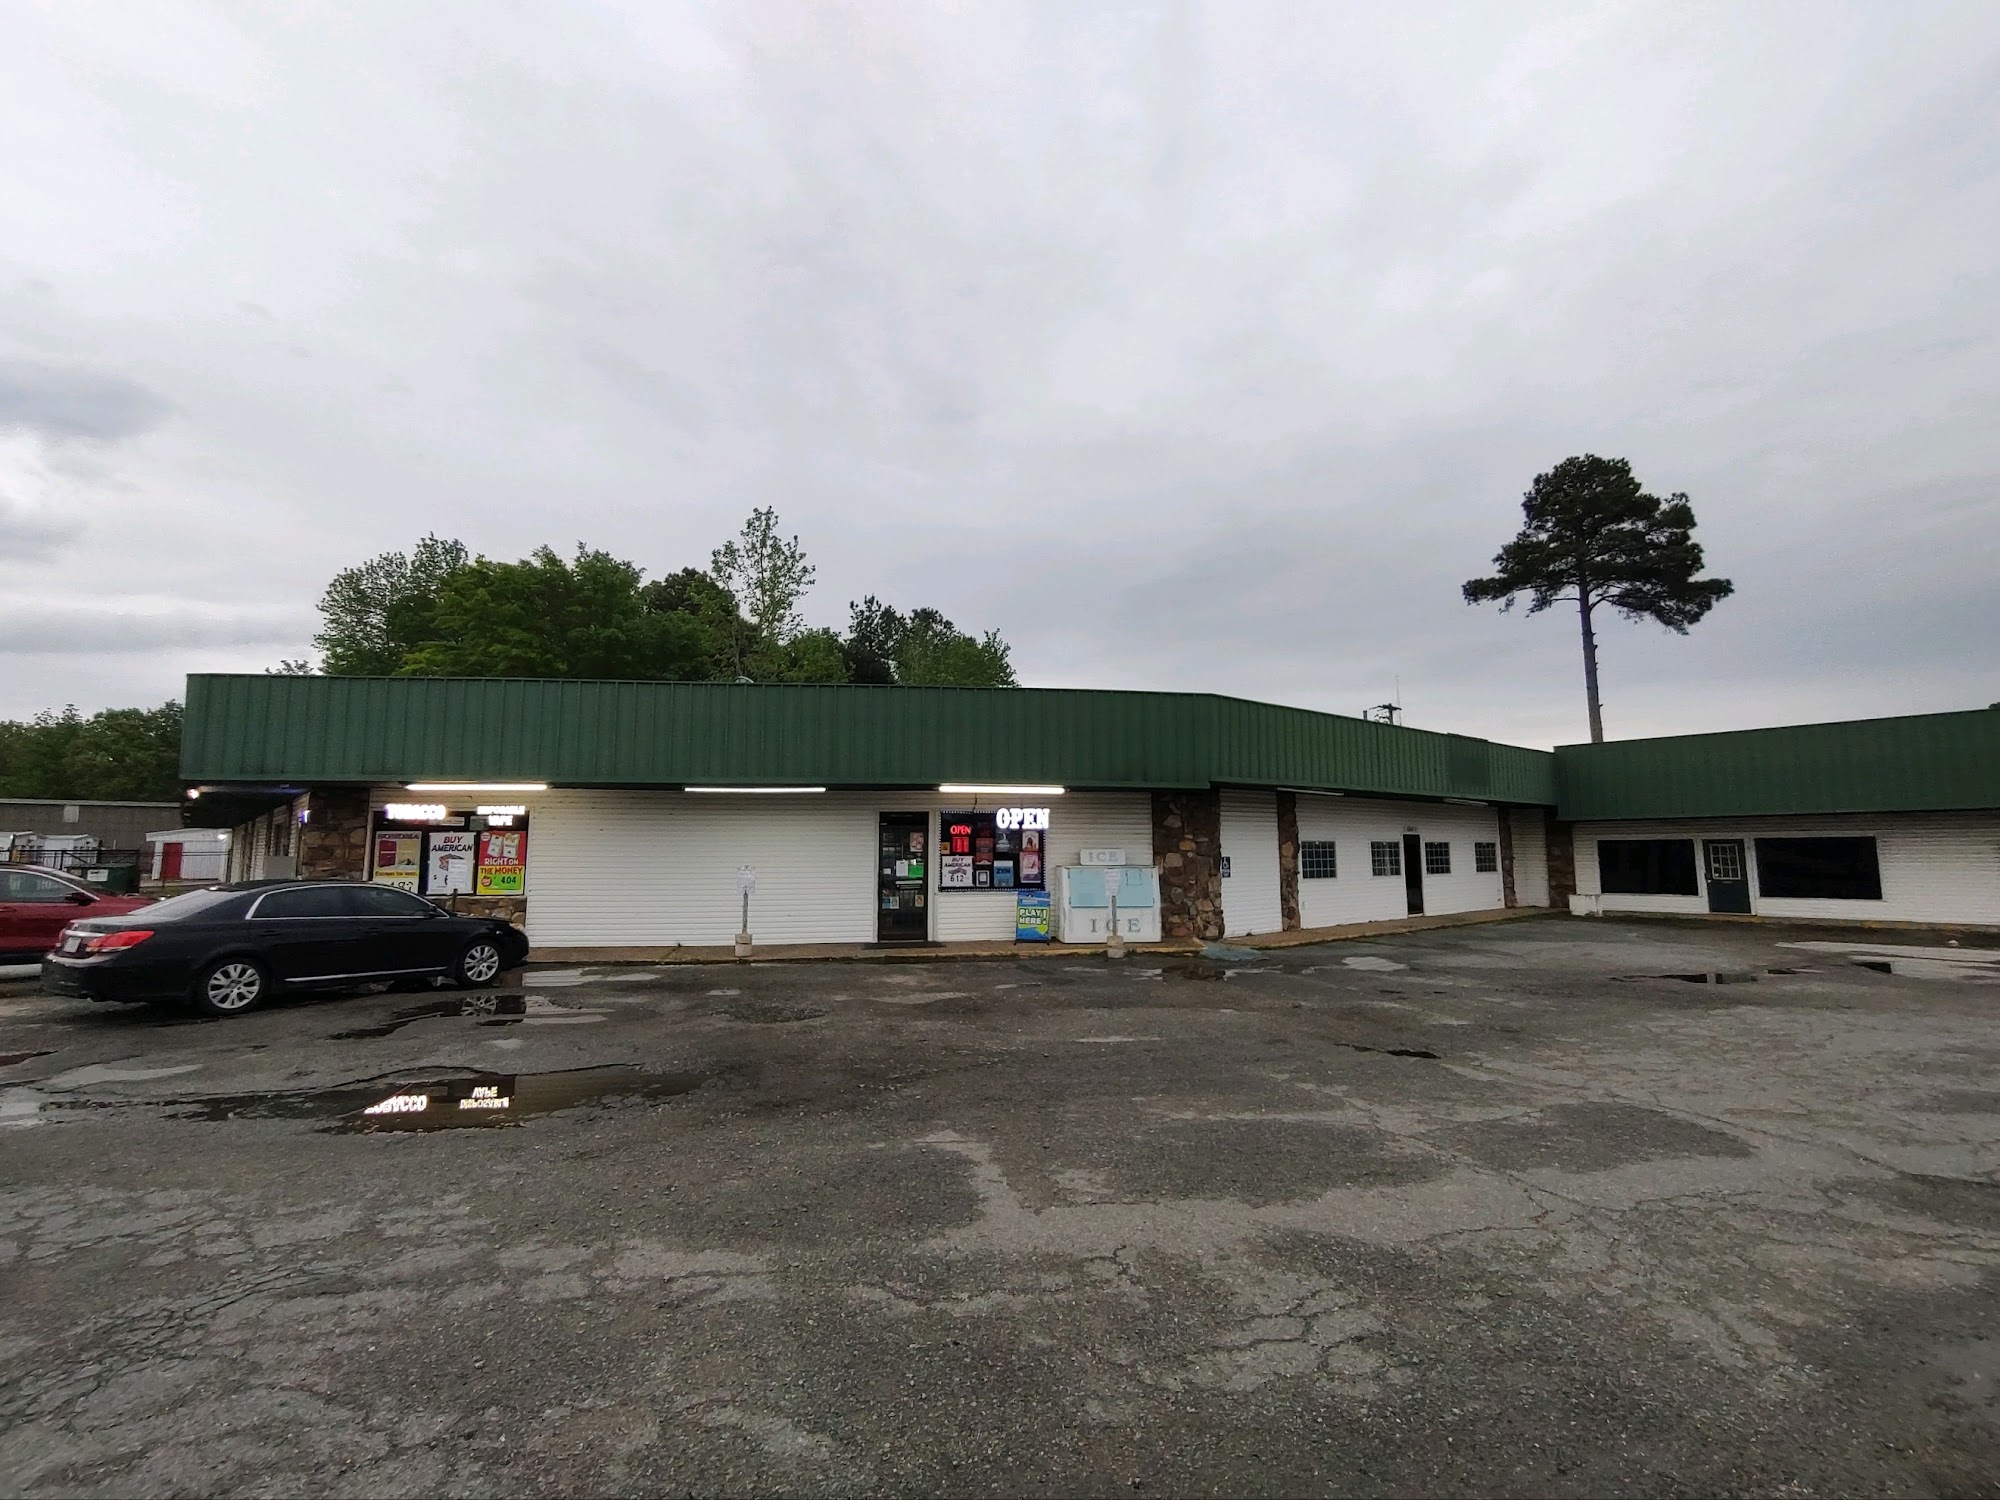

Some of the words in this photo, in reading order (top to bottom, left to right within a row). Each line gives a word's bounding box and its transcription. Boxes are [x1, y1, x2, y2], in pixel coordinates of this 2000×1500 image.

[996, 808, 1050, 829] OPEN
[950, 824, 972, 835] OPEN
[443, 835, 465, 844] BUY
[431, 844, 473, 852] AMERICAN
[1088, 851, 1119, 861] ICE
[484, 857, 508, 866] RIGHT
[508, 858, 519, 866] ON
[480, 867, 493, 875] THE
[494, 866, 523, 875] MONEY
[501, 876, 516, 884] 404
